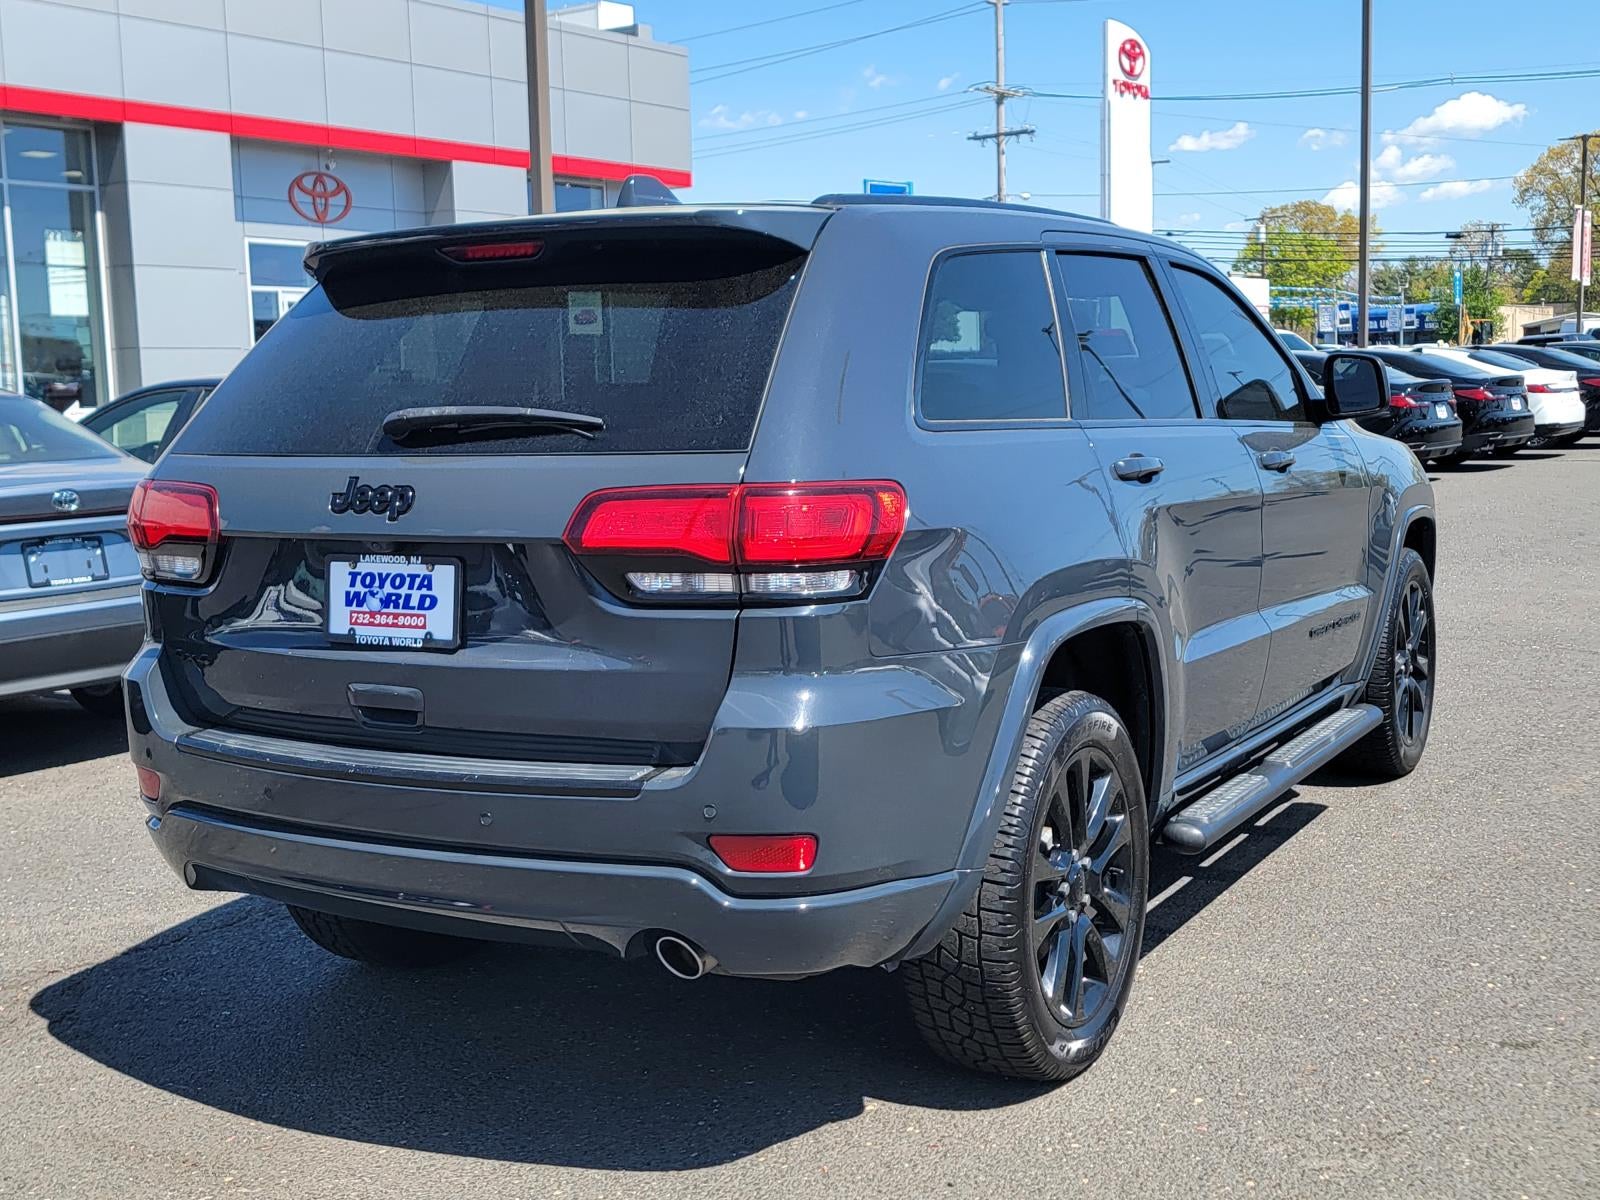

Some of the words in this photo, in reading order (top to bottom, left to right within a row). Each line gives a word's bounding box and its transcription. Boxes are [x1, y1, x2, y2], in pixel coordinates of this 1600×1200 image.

[329, 476, 416, 523] Jeep
[360, 554, 409, 566] LAKEWOOD,
[410, 556, 422, 564] NJ
[348, 571, 433, 591] TOYOTA
[345, 590, 438, 611] WORLD
[351, 613, 425, 626] 732-364-9000
[355, 635, 390, 646] TOYOTA
[391, 637, 423, 647] WORLD
